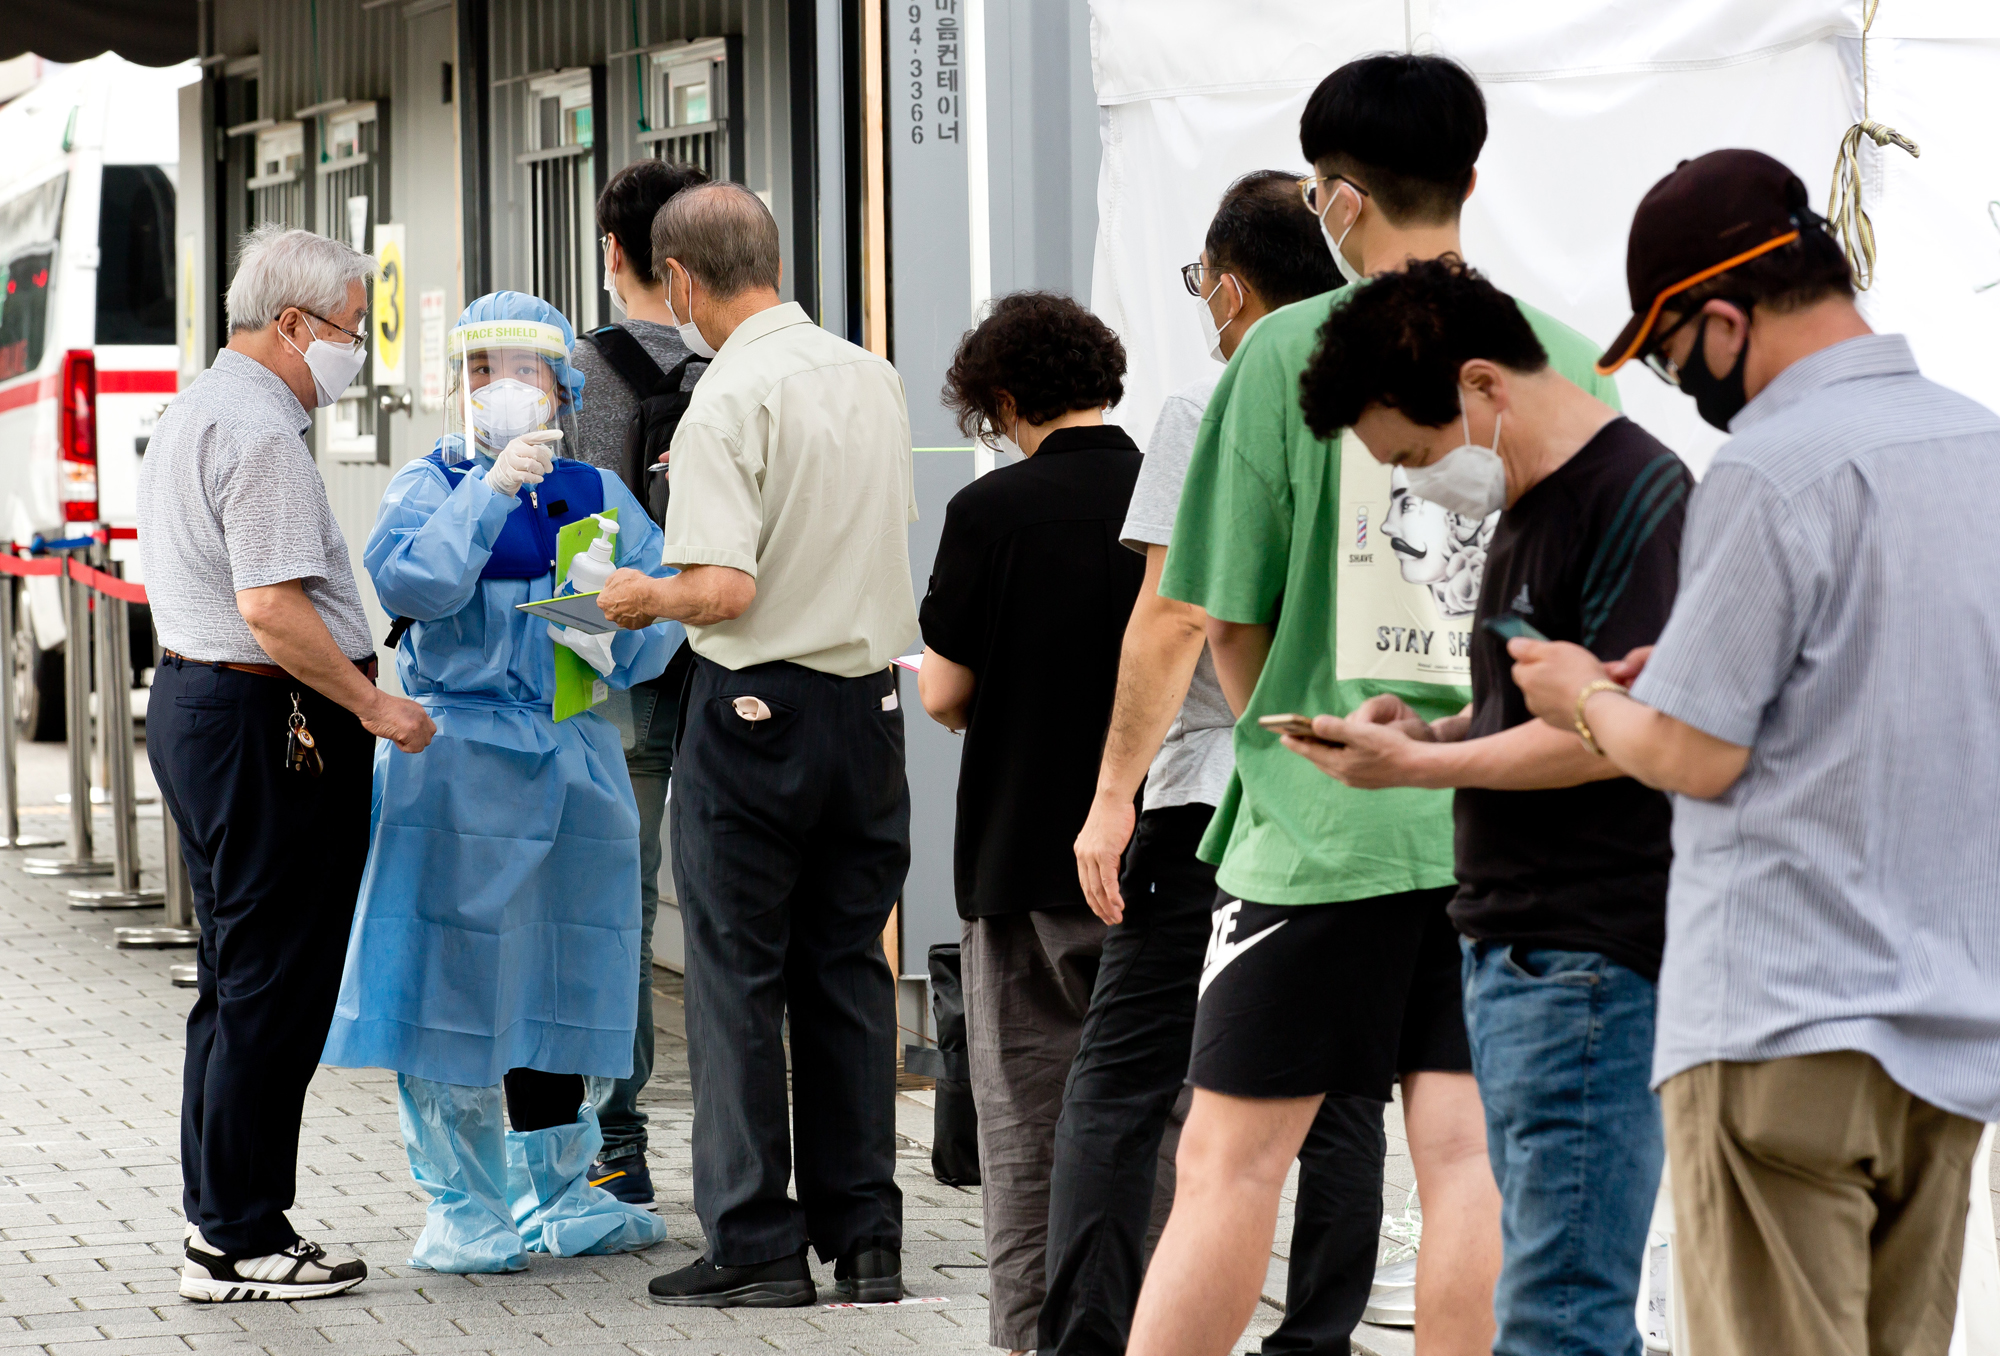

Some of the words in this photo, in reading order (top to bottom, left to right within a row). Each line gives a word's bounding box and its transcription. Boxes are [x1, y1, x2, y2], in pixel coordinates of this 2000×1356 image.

[908, 0, 924, 145] 94-3366
[381, 260, 399, 342] 3
[467, 328, 493, 340] FACE
[495, 327, 538, 338] SHIELD
[1349, 554, 1374, 563] SHAVE
[1376, 625, 1434, 655] STAY
